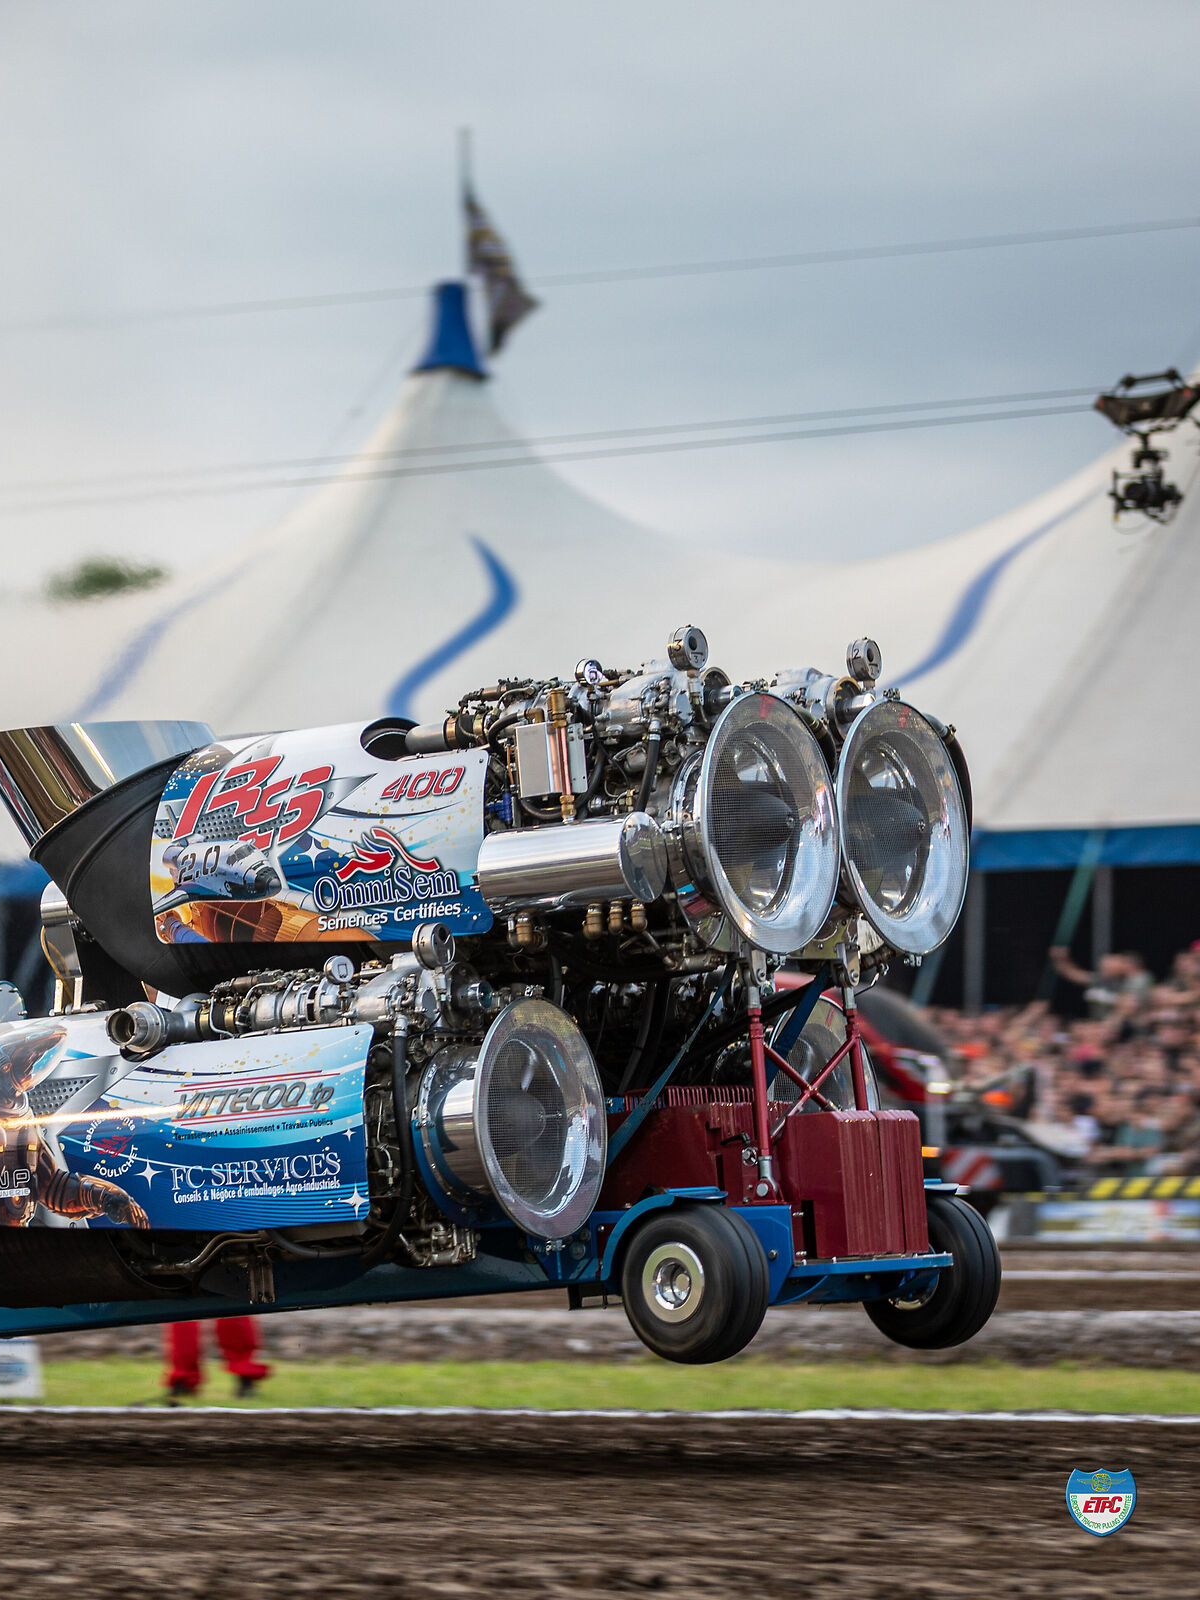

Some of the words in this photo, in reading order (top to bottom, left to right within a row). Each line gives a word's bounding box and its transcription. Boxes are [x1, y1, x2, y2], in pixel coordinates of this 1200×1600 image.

[853, 648, 861, 660] 2
[381, 766, 465, 801] 400
[178, 845, 221, 884] 2.0
[314, 866, 460, 911] OmniSem
[318, 912, 388, 931] Semences
[394, 901, 461, 922] Certifiées
[177, 1083, 306, 1118] VITTECOQ
[310, 1082, 335, 1110] tp
[174, 1130, 218, 1141] Terrassement
[224, 1125, 275, 1136] Assainissement
[281, 1120, 308, 1131] Travaux
[309, 1118, 334, 1128] Publics
[93, 1144, 139, 1177] POULICHET
[171, 1166, 205, 1190] FC
[211, 1152, 341, 1187] SERVICES
[173, 1190, 202, 1204] Conseils
[203, 1190, 210, 1201] &
